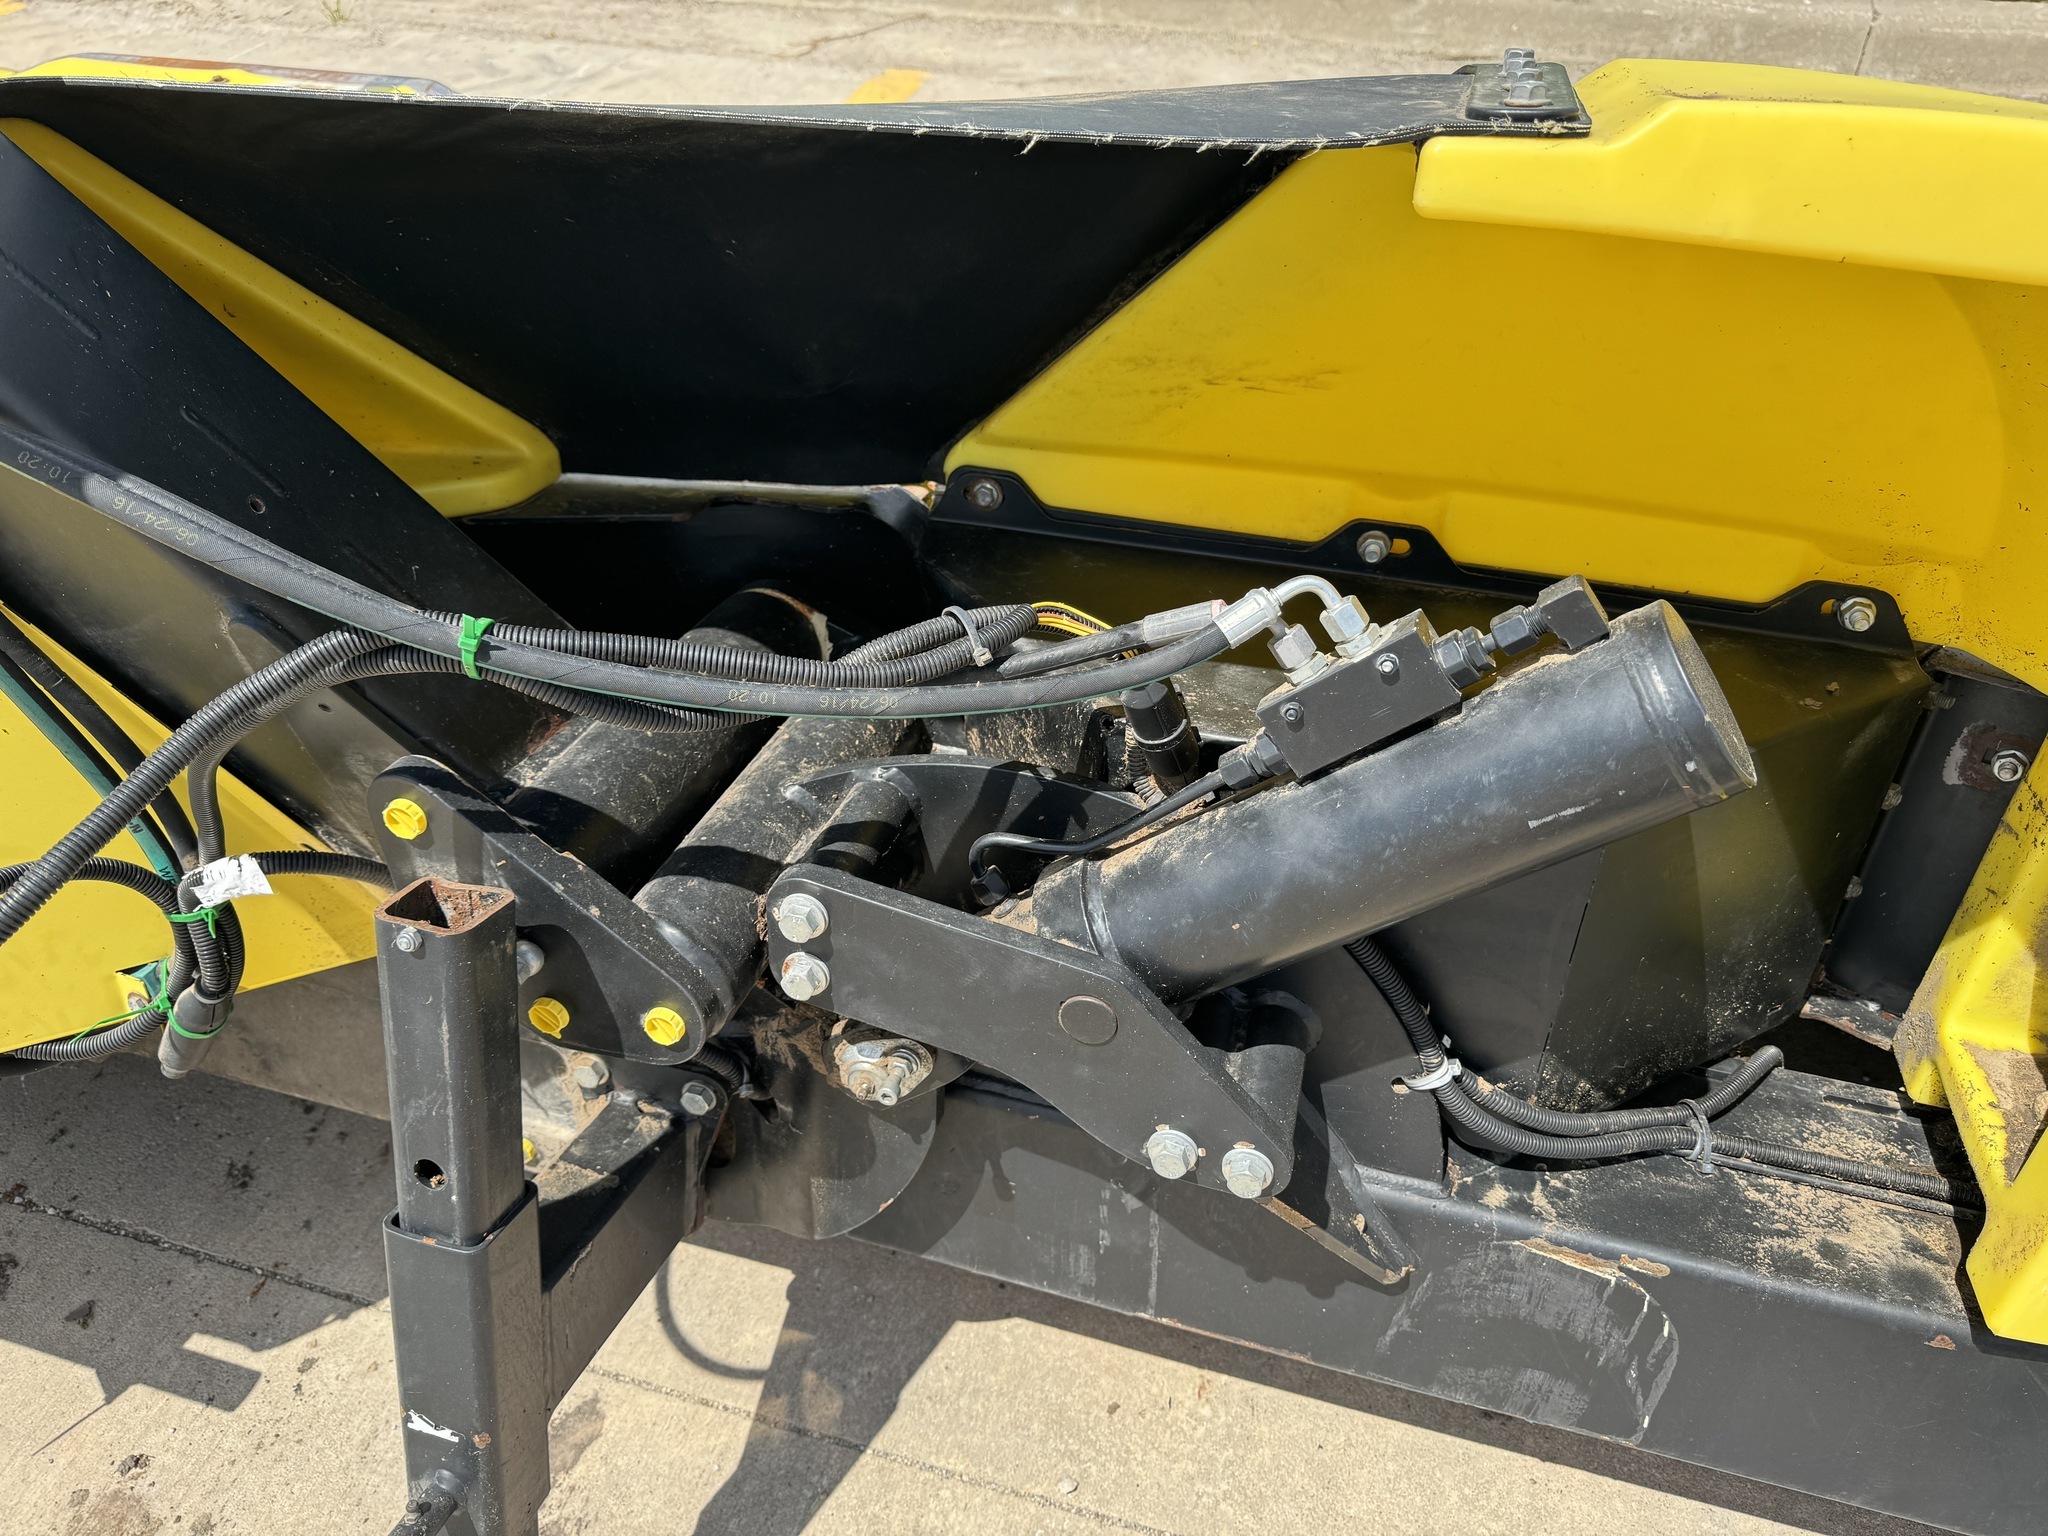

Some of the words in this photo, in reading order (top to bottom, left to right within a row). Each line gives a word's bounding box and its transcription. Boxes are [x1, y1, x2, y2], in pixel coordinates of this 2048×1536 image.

[17, 450, 71, 484] 10:20
[112, 496, 199, 546] 06/24/16
[729, 688, 777, 706] 10:20
[820, 694, 899, 710] 06/24/16
